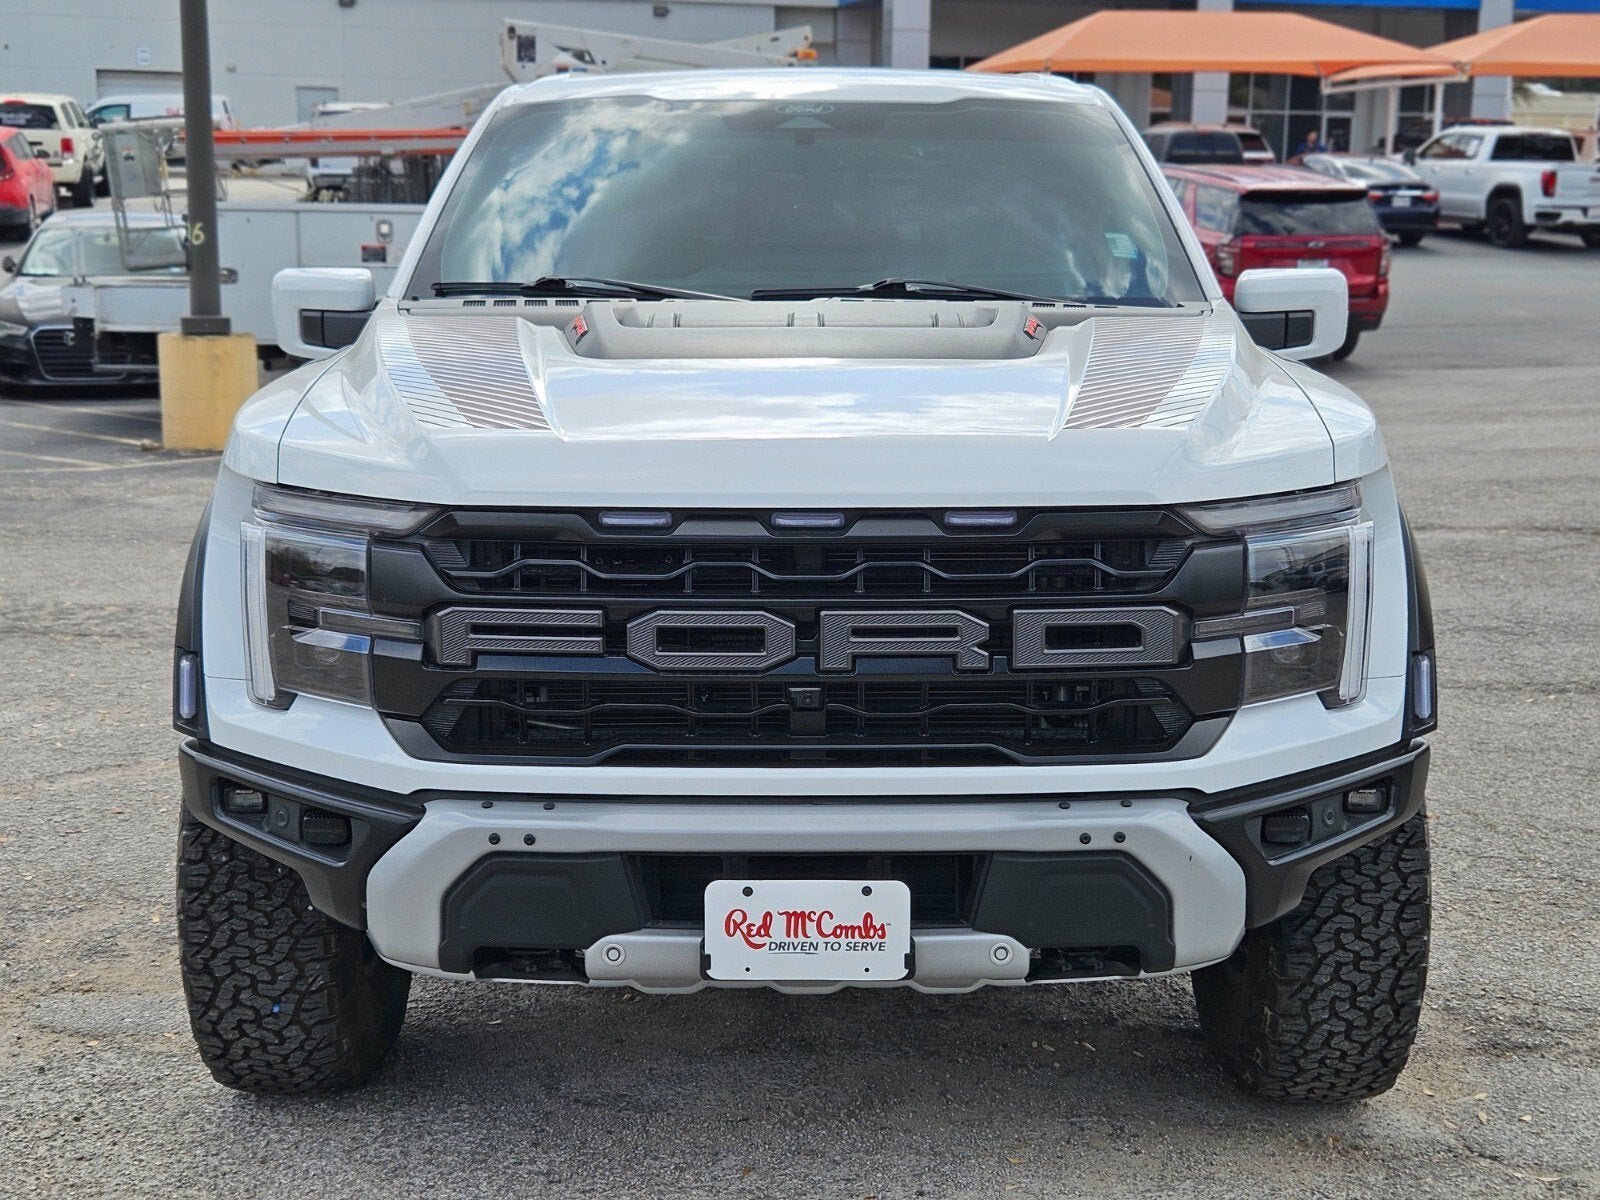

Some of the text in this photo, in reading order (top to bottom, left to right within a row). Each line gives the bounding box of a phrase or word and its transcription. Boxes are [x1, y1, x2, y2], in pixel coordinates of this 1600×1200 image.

[785, 103, 823, 113] Ford
[433, 605, 1185, 671] FORD
[724, 908, 887, 950] Red McCombs
[768, 941, 887, 951] DRIVEN TO SERVE
